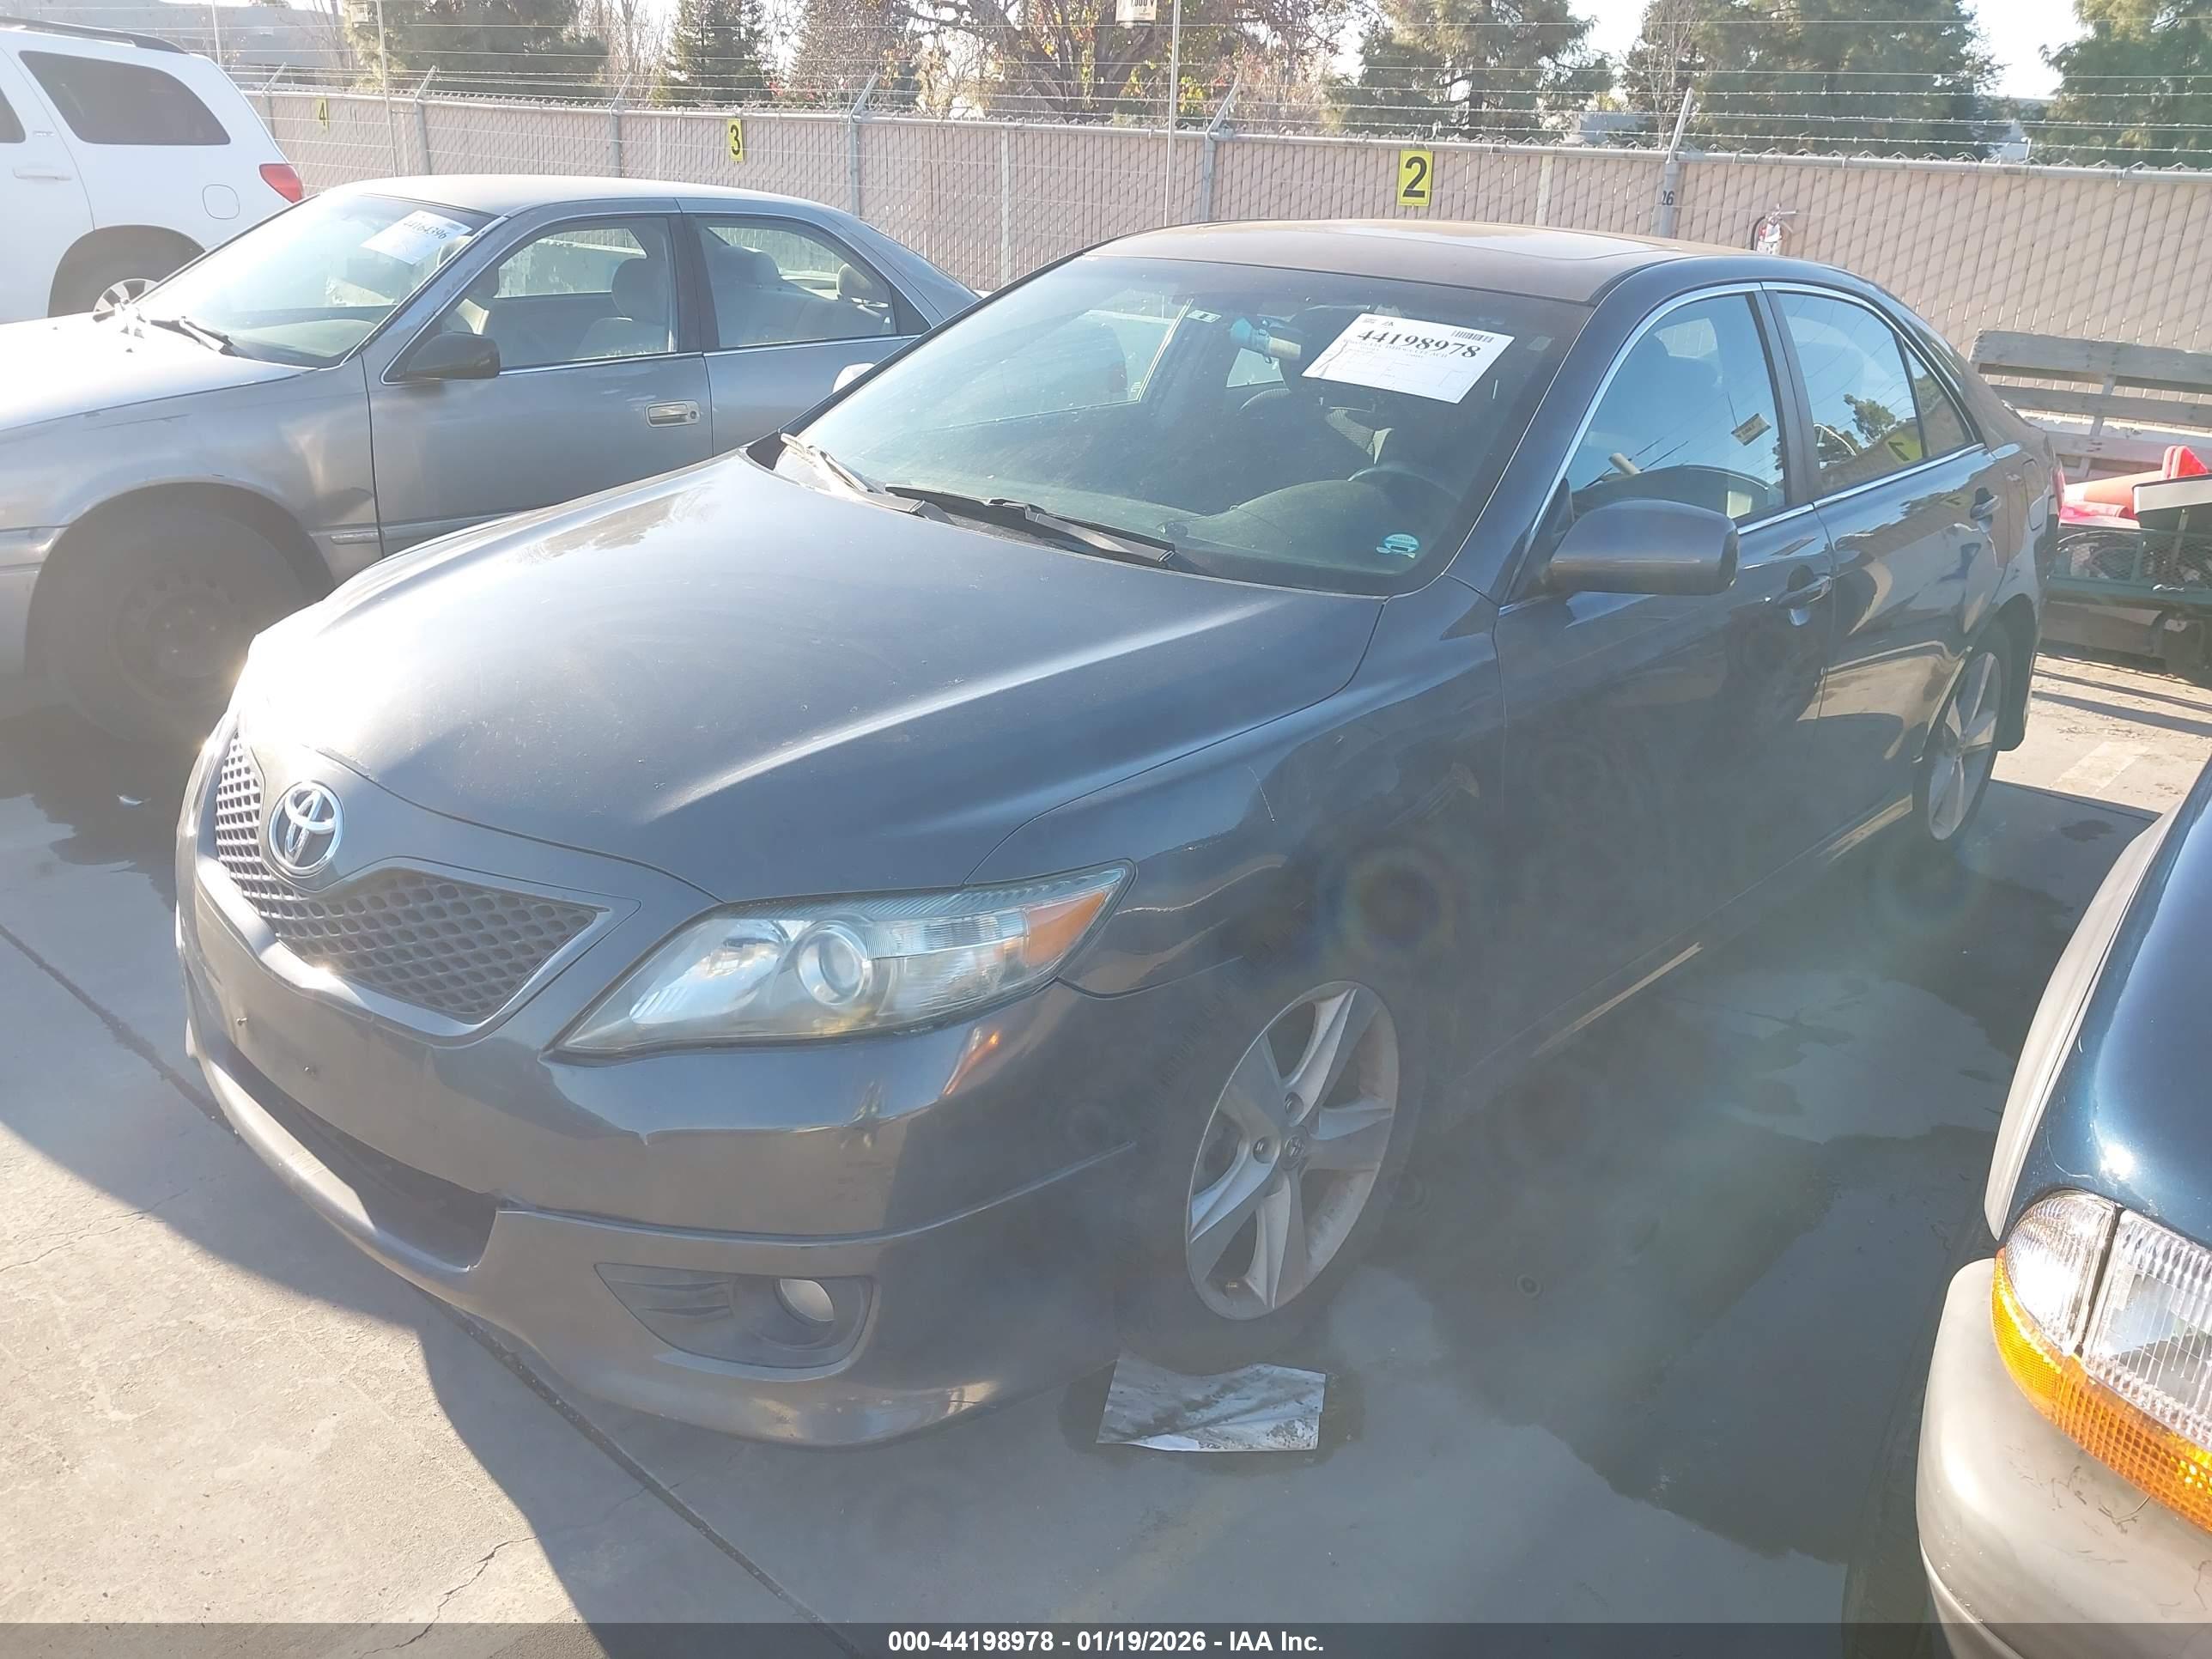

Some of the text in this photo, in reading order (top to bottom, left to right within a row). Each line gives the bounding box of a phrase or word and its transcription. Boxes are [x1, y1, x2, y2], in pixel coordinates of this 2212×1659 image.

[319, 102, 326, 126] 4
[730, 125, 740, 155] 3
[1402, 156, 1427, 198] 2
[1357, 330, 1481, 358] 44198978
